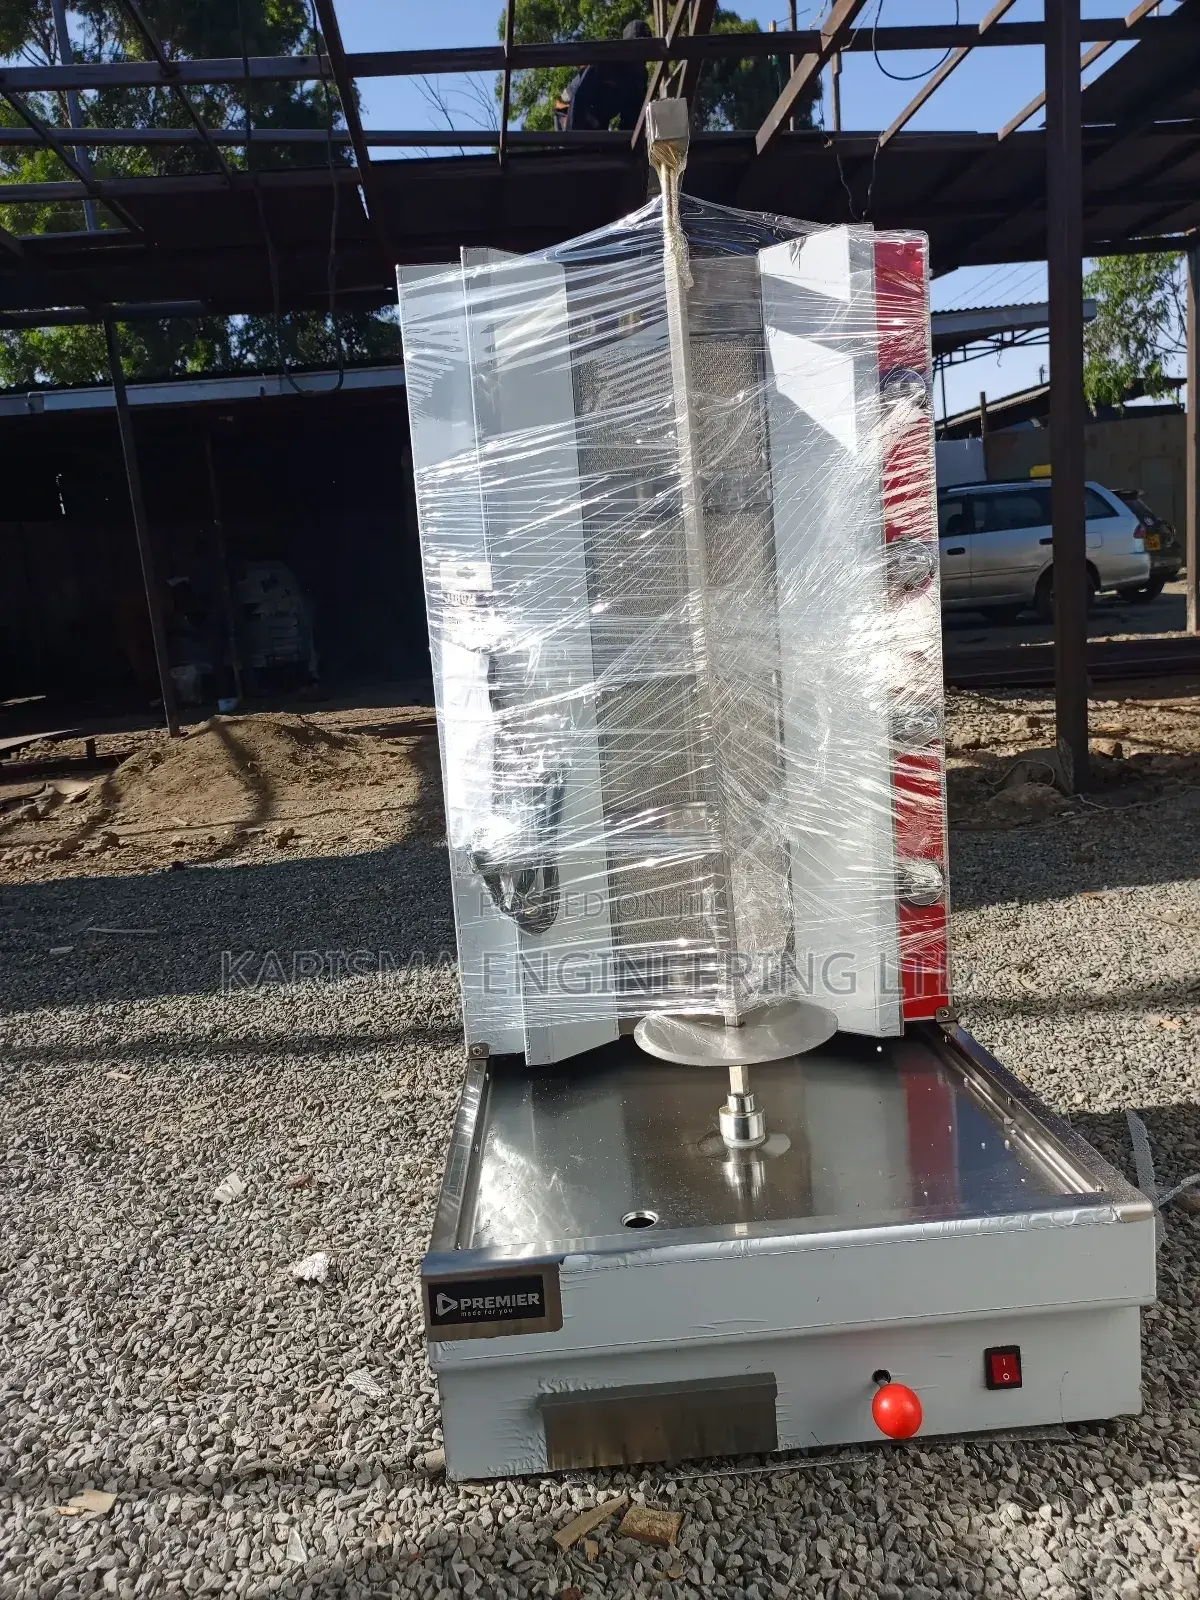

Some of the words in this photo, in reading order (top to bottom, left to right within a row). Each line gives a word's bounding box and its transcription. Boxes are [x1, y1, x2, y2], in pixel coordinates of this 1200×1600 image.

[460, 1293, 540, 1311] PREMIER
[461, 1308, 481, 1317] made
[498, 1308, 513, 1316] you
